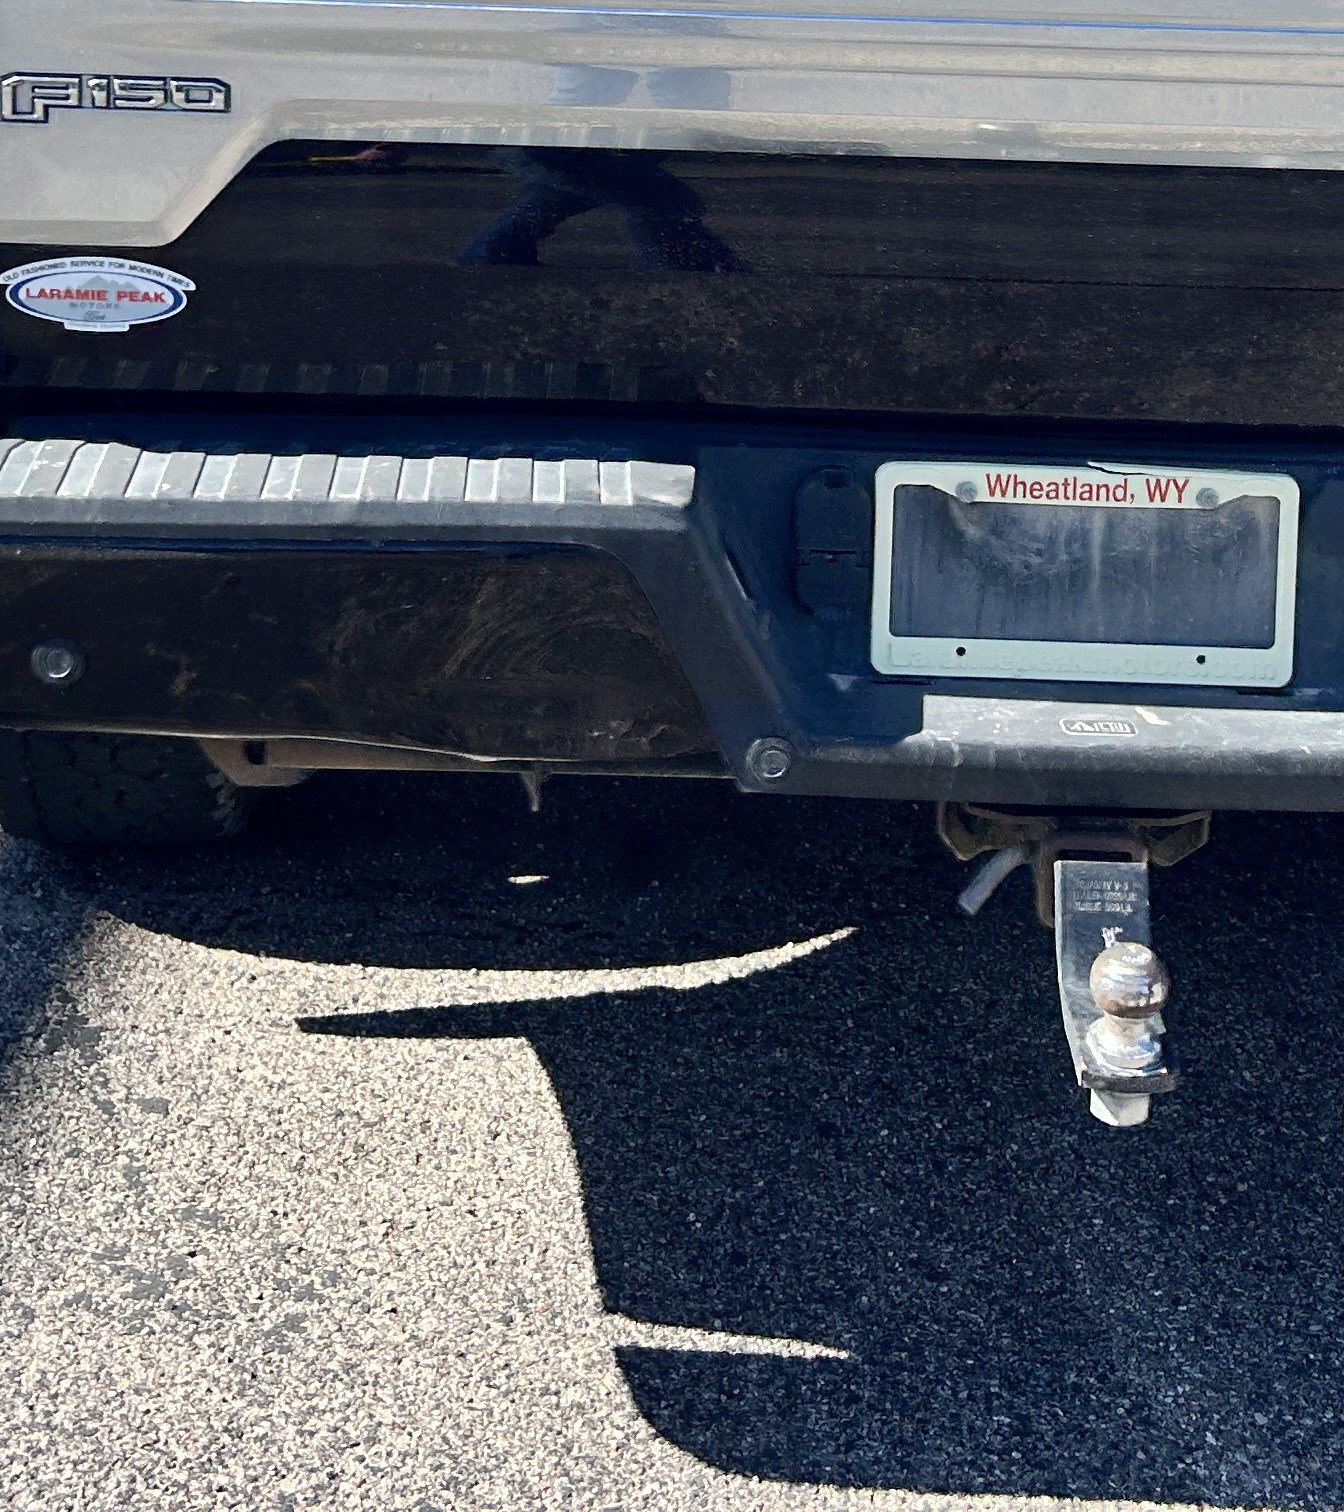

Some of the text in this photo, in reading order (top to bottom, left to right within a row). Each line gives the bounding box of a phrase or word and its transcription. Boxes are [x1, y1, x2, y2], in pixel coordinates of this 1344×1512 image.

[108, 261, 126, 269] FOR
[25, 288, 167, 303] LARAMIE PEAK
[985, 473, 1190, 505] Wheatland, WY
